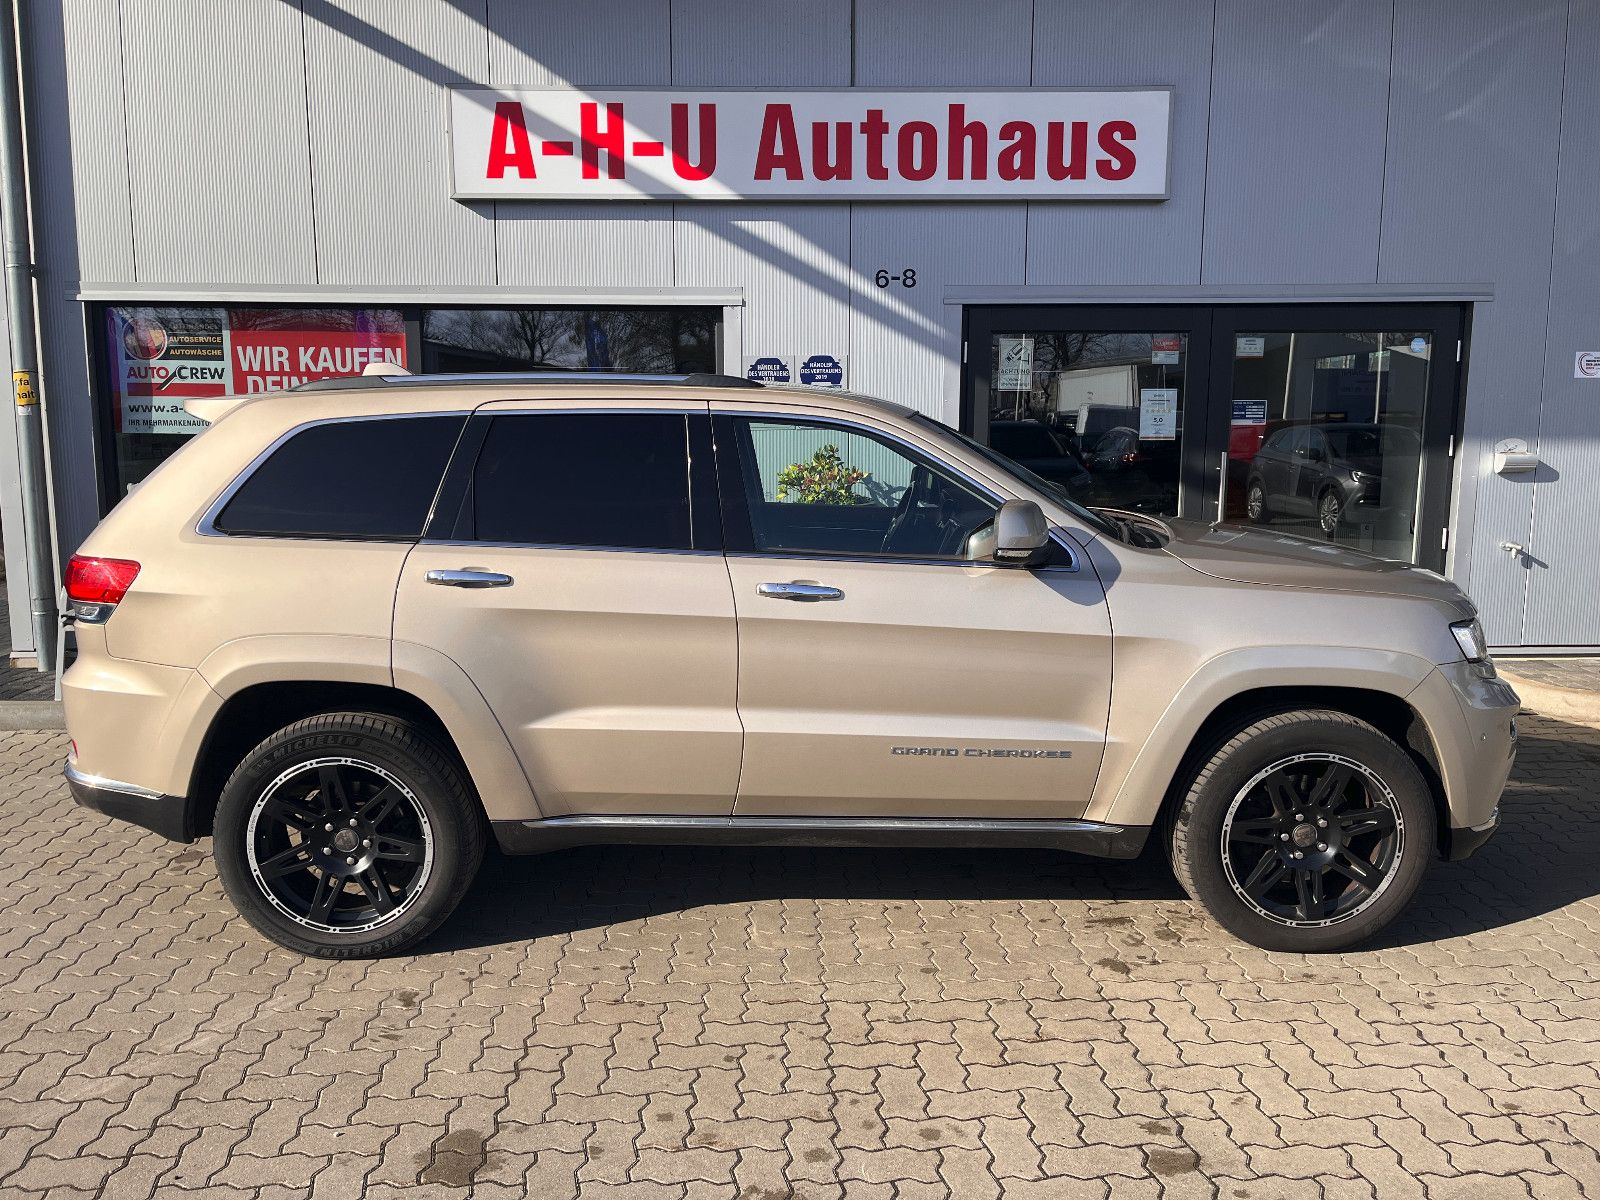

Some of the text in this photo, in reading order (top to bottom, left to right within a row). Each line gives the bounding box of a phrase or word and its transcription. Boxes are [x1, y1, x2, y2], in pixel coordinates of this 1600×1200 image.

[486, 101, 1137, 181] A-H-U Autohaus
[875, 269, 917, 288] 6-8
[237, 346, 402, 373] WIR KAUFEN
[127, 365, 225, 380] AUTO CREW
[143, 419, 212, 427] MEHRMARKENAUTO
[891, 746, 1073, 759] GRAND CHEROKEE
